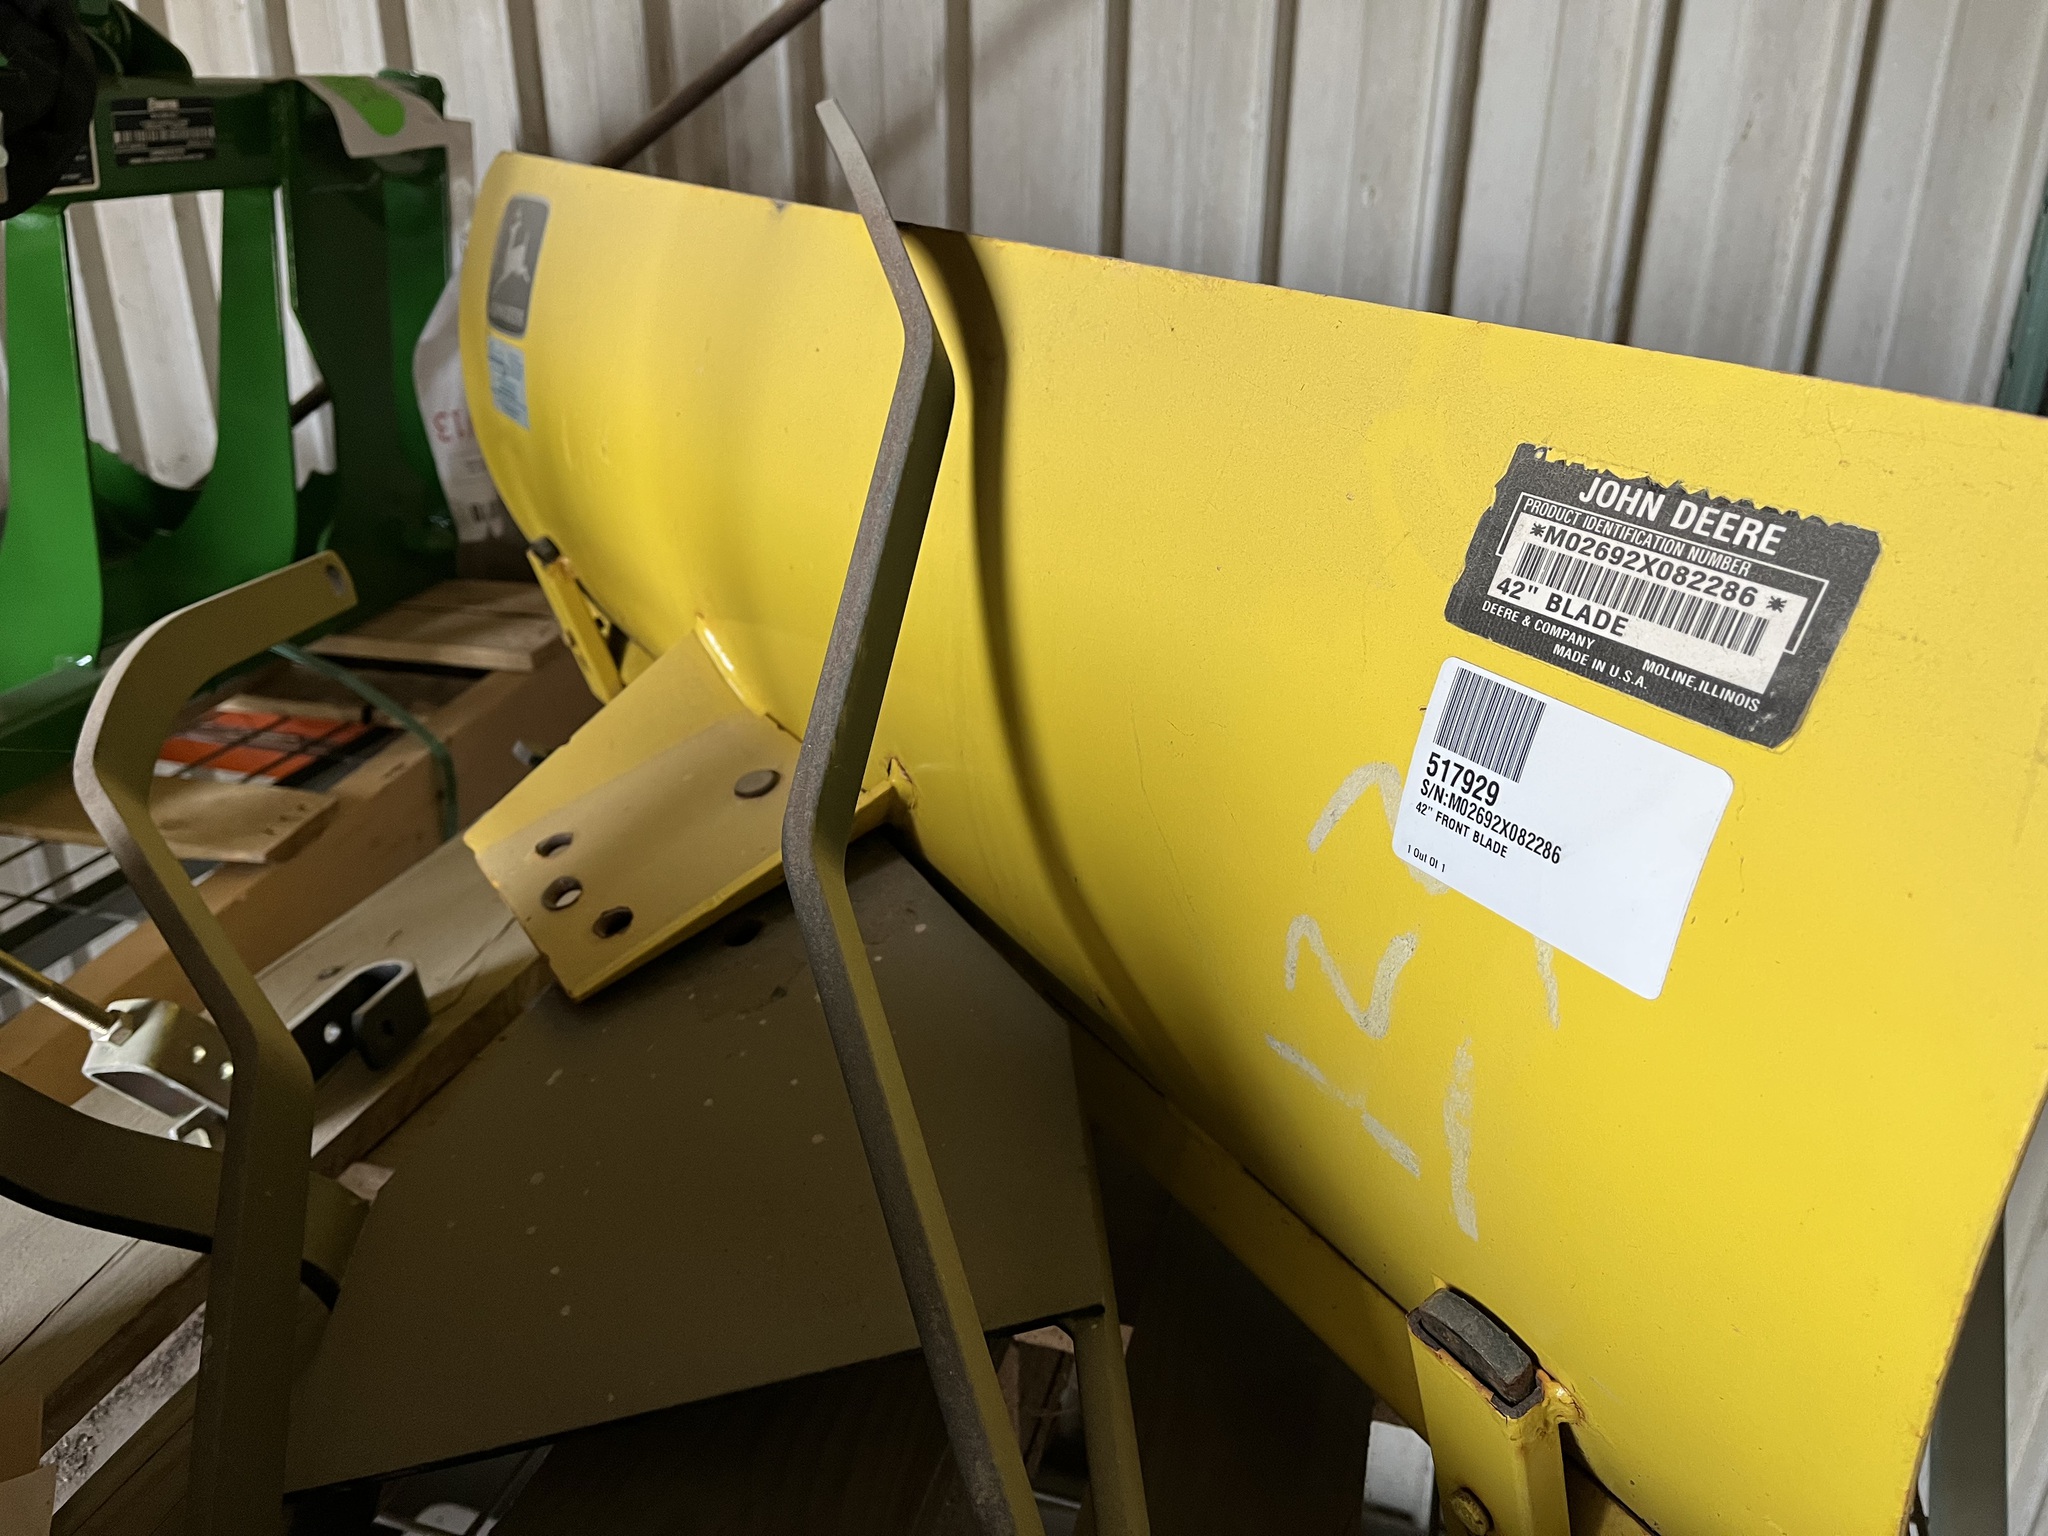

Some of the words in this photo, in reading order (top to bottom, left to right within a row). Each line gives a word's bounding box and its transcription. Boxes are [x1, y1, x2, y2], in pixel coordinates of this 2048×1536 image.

[1523, 498, 1582, 528] PRODUCT
[1583, 515, 1685, 558] IDENTIFICATION
[1687, 545, 1753, 578] NUMBER
[1578, 476, 1665, 523] JOHN
[1671, 499, 1787, 556] DEERE
[1481, 599, 1520, 624] DEERE
[1521, 613, 1533, 628] &
[1533, 617, 1596, 651] COMPANY
[1545, 592, 1629, 638] BLADE
[1553, 643, 1590, 668] MADE
[1590, 656, 1606, 675] IN
[1607, 663, 1649, 691] U.S.A.
[1426, 751, 1501, 807] 517929
[1420, 778, 1562, 865] S/N:M02692X082286
[1435, 810, 1471, 839] FRONT
[1472, 829, 1509, 858] BLADE
[1407, 844, 1412, 854] 1
[1441, 863, 1446, 873] 1
